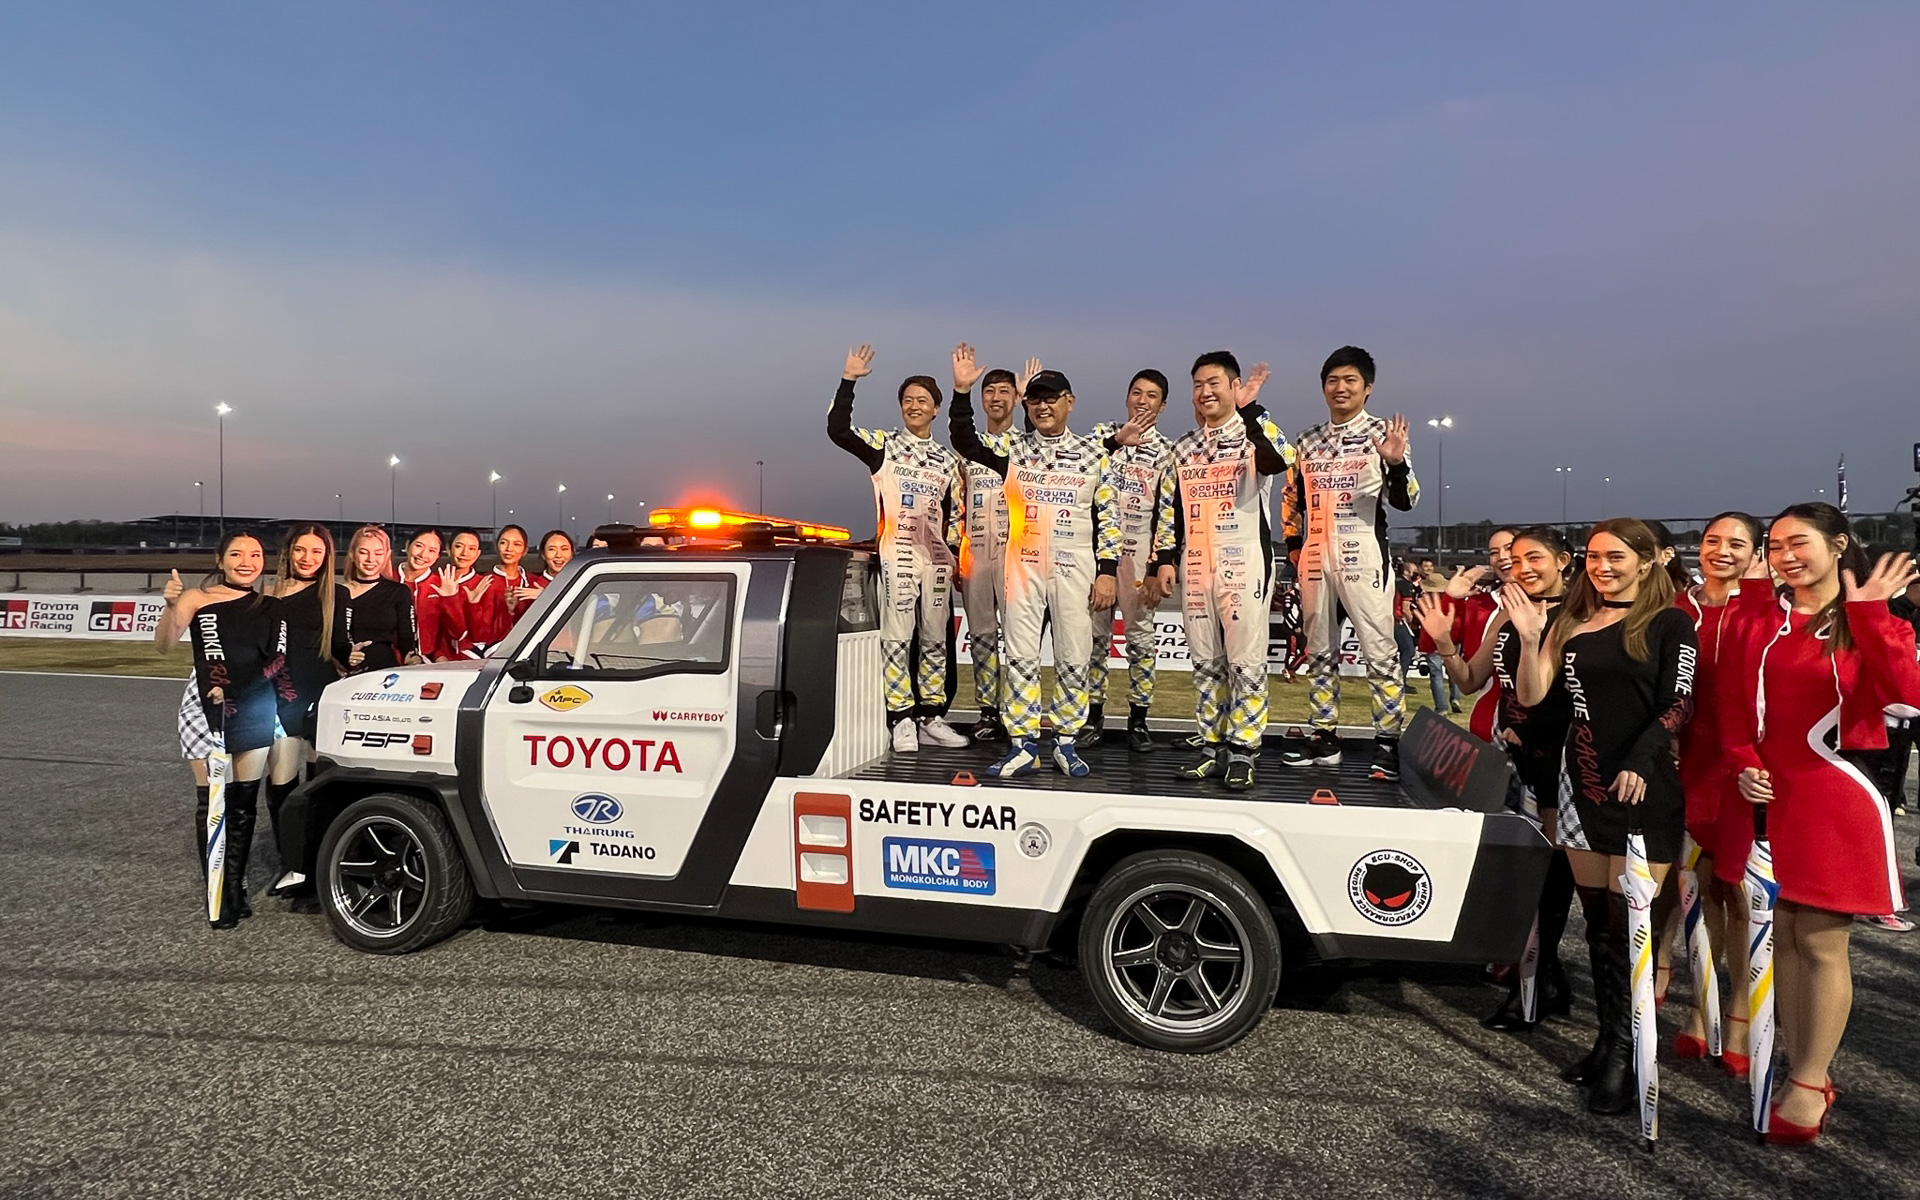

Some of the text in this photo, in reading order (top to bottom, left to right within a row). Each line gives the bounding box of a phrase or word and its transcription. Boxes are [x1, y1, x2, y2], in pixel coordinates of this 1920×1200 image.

[1016, 470, 1047, 485] ROOKIE
[1048, 475, 1086, 487] RACING
[1035, 489, 1074, 498] OGURA
[1035, 496, 1073, 504] CLUTCH
[32, 602, 79, 611] TOYOTA
[31, 612, 74, 621] GAZOO
[90, 613, 133, 631] GR
[30, 621, 72, 633] Racing
[197, 613, 226, 661] ROOKIE
[1674, 643, 1697, 696] ROOKIE
[548, 694, 582, 704] MPC
[670, 712, 725, 722] CARRYBOY
[341, 730, 411, 748] PSP
[523, 735, 683, 774] TOYOTA
[1417, 717, 1480, 797] TOYOTA
[859, 798, 1016, 831] SAFETY CAR
[563, 826, 635, 839] THAIRUNG
[590, 842, 656, 860] TADANO
[889, 844, 961, 877] MKC
[890, 873, 989, 889] MONGKOLCHAI BODY
[1418, 881, 1428, 911] WHERE
[1356, 899, 1417, 922] PERFORMANCE
